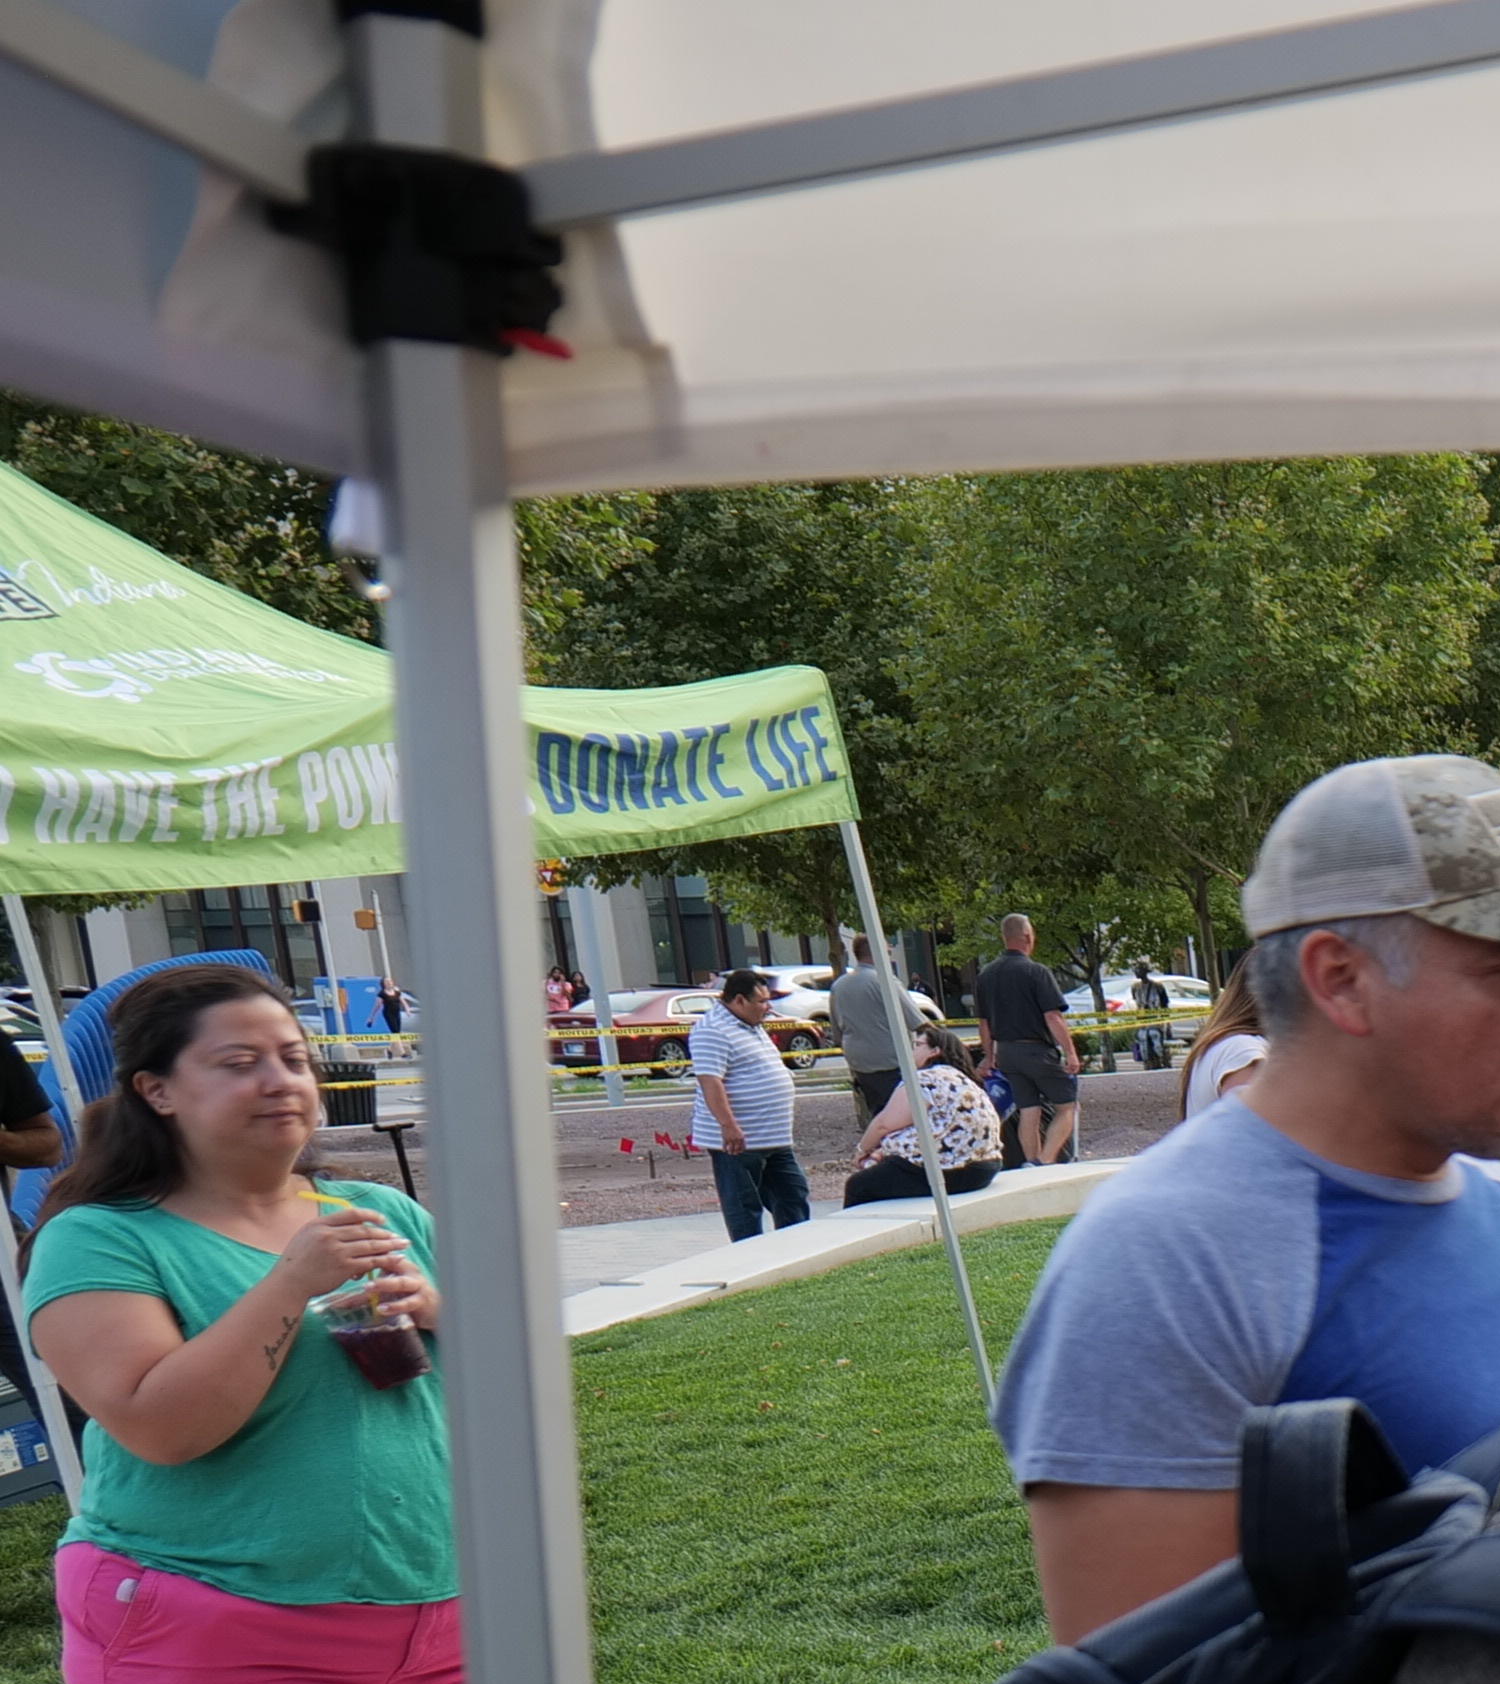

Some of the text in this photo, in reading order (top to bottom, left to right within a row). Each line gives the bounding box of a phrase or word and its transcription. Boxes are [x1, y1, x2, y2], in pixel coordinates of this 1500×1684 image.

[33, 766, 180, 844] HAVE
[189, 756, 285, 842] THE
[297, 742, 405, 833] POW
[537, 723, 744, 815] DONATE
[745, 705, 838, 792] LIFE
